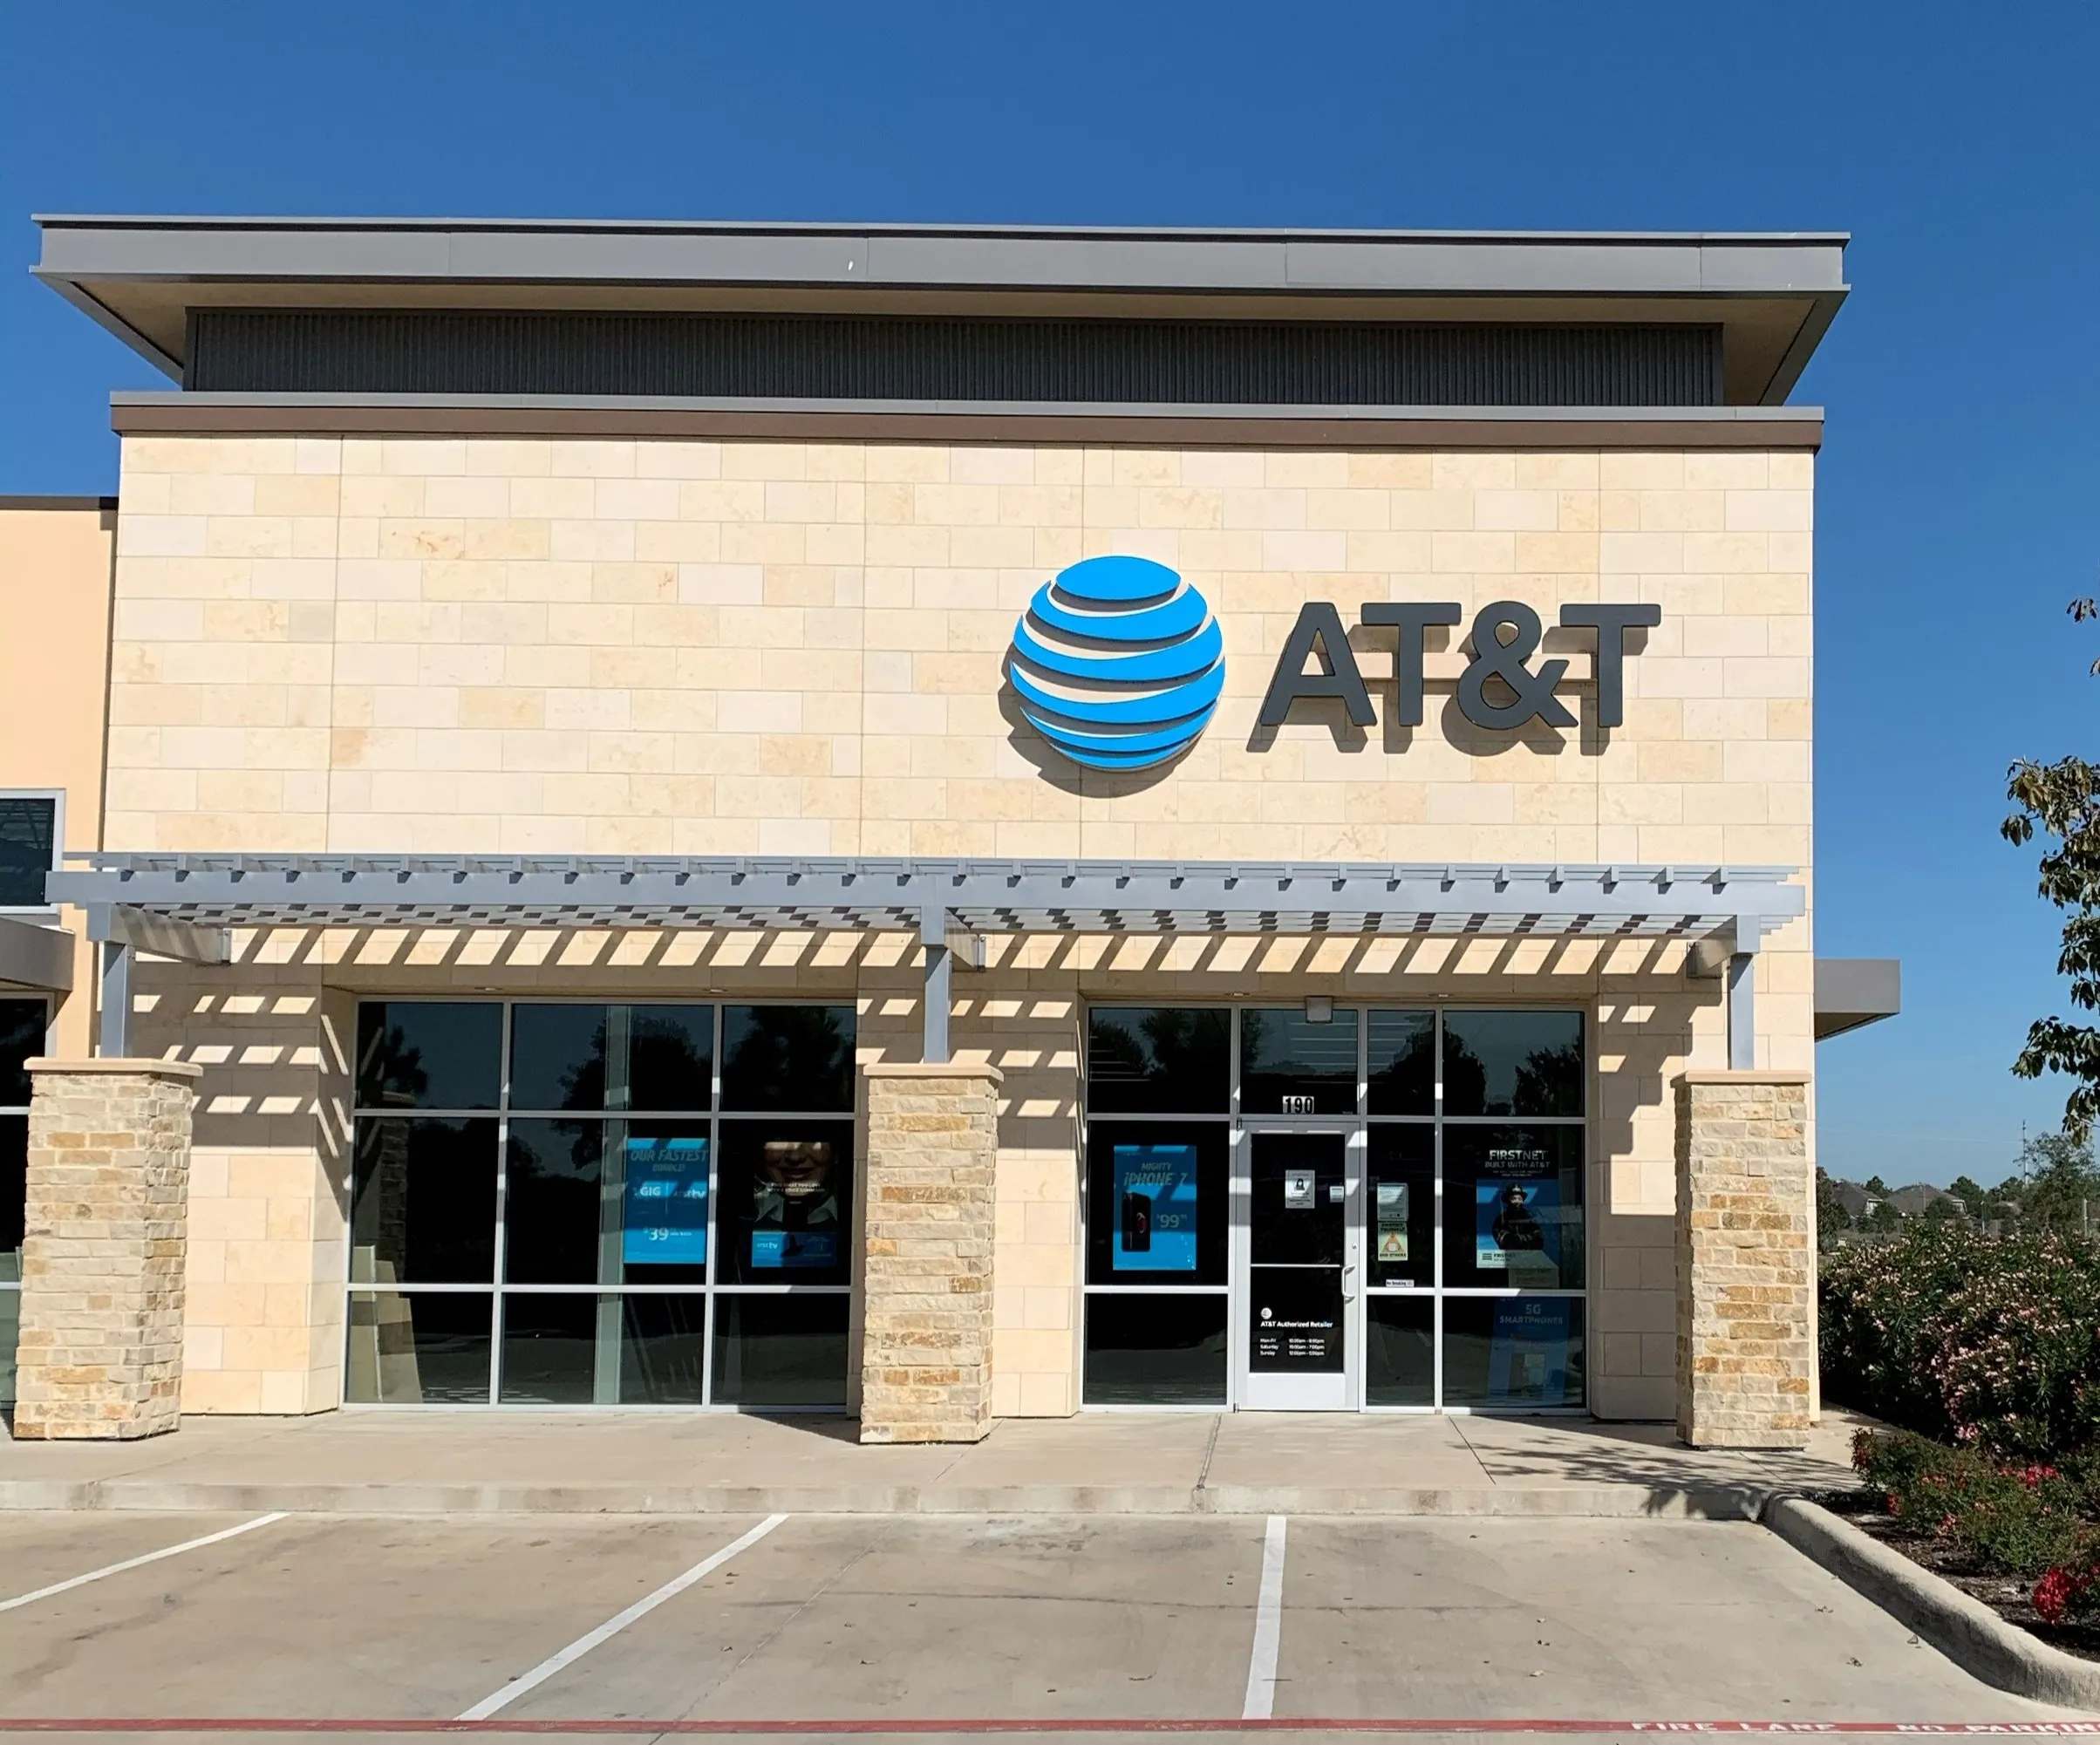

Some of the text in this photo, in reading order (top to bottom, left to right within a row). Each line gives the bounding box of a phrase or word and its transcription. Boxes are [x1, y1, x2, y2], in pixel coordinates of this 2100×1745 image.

[1259, 600, 1662, 730] AT&T
[1285, 1097, 1313, 1114] 190
[630, 1149, 708, 1162] OUR FASTEST
[1489, 1149, 1546, 1161] FIRSTNET
[1141, 1162, 1172, 1171] MIGHTY
[1123, 1172, 1188, 1186] iPHONE 7
[639, 1186, 661, 1196] GIG
[1525, 1304, 1542, 1315] 5G
[1499, 1315, 1563, 1325] SMARTPHONES
[1631, 1722, 1719, 1731] FIRE
[1739, 1722, 1836, 1732] LANE
[1965, 1723, 2100, 1733] PARKIN
